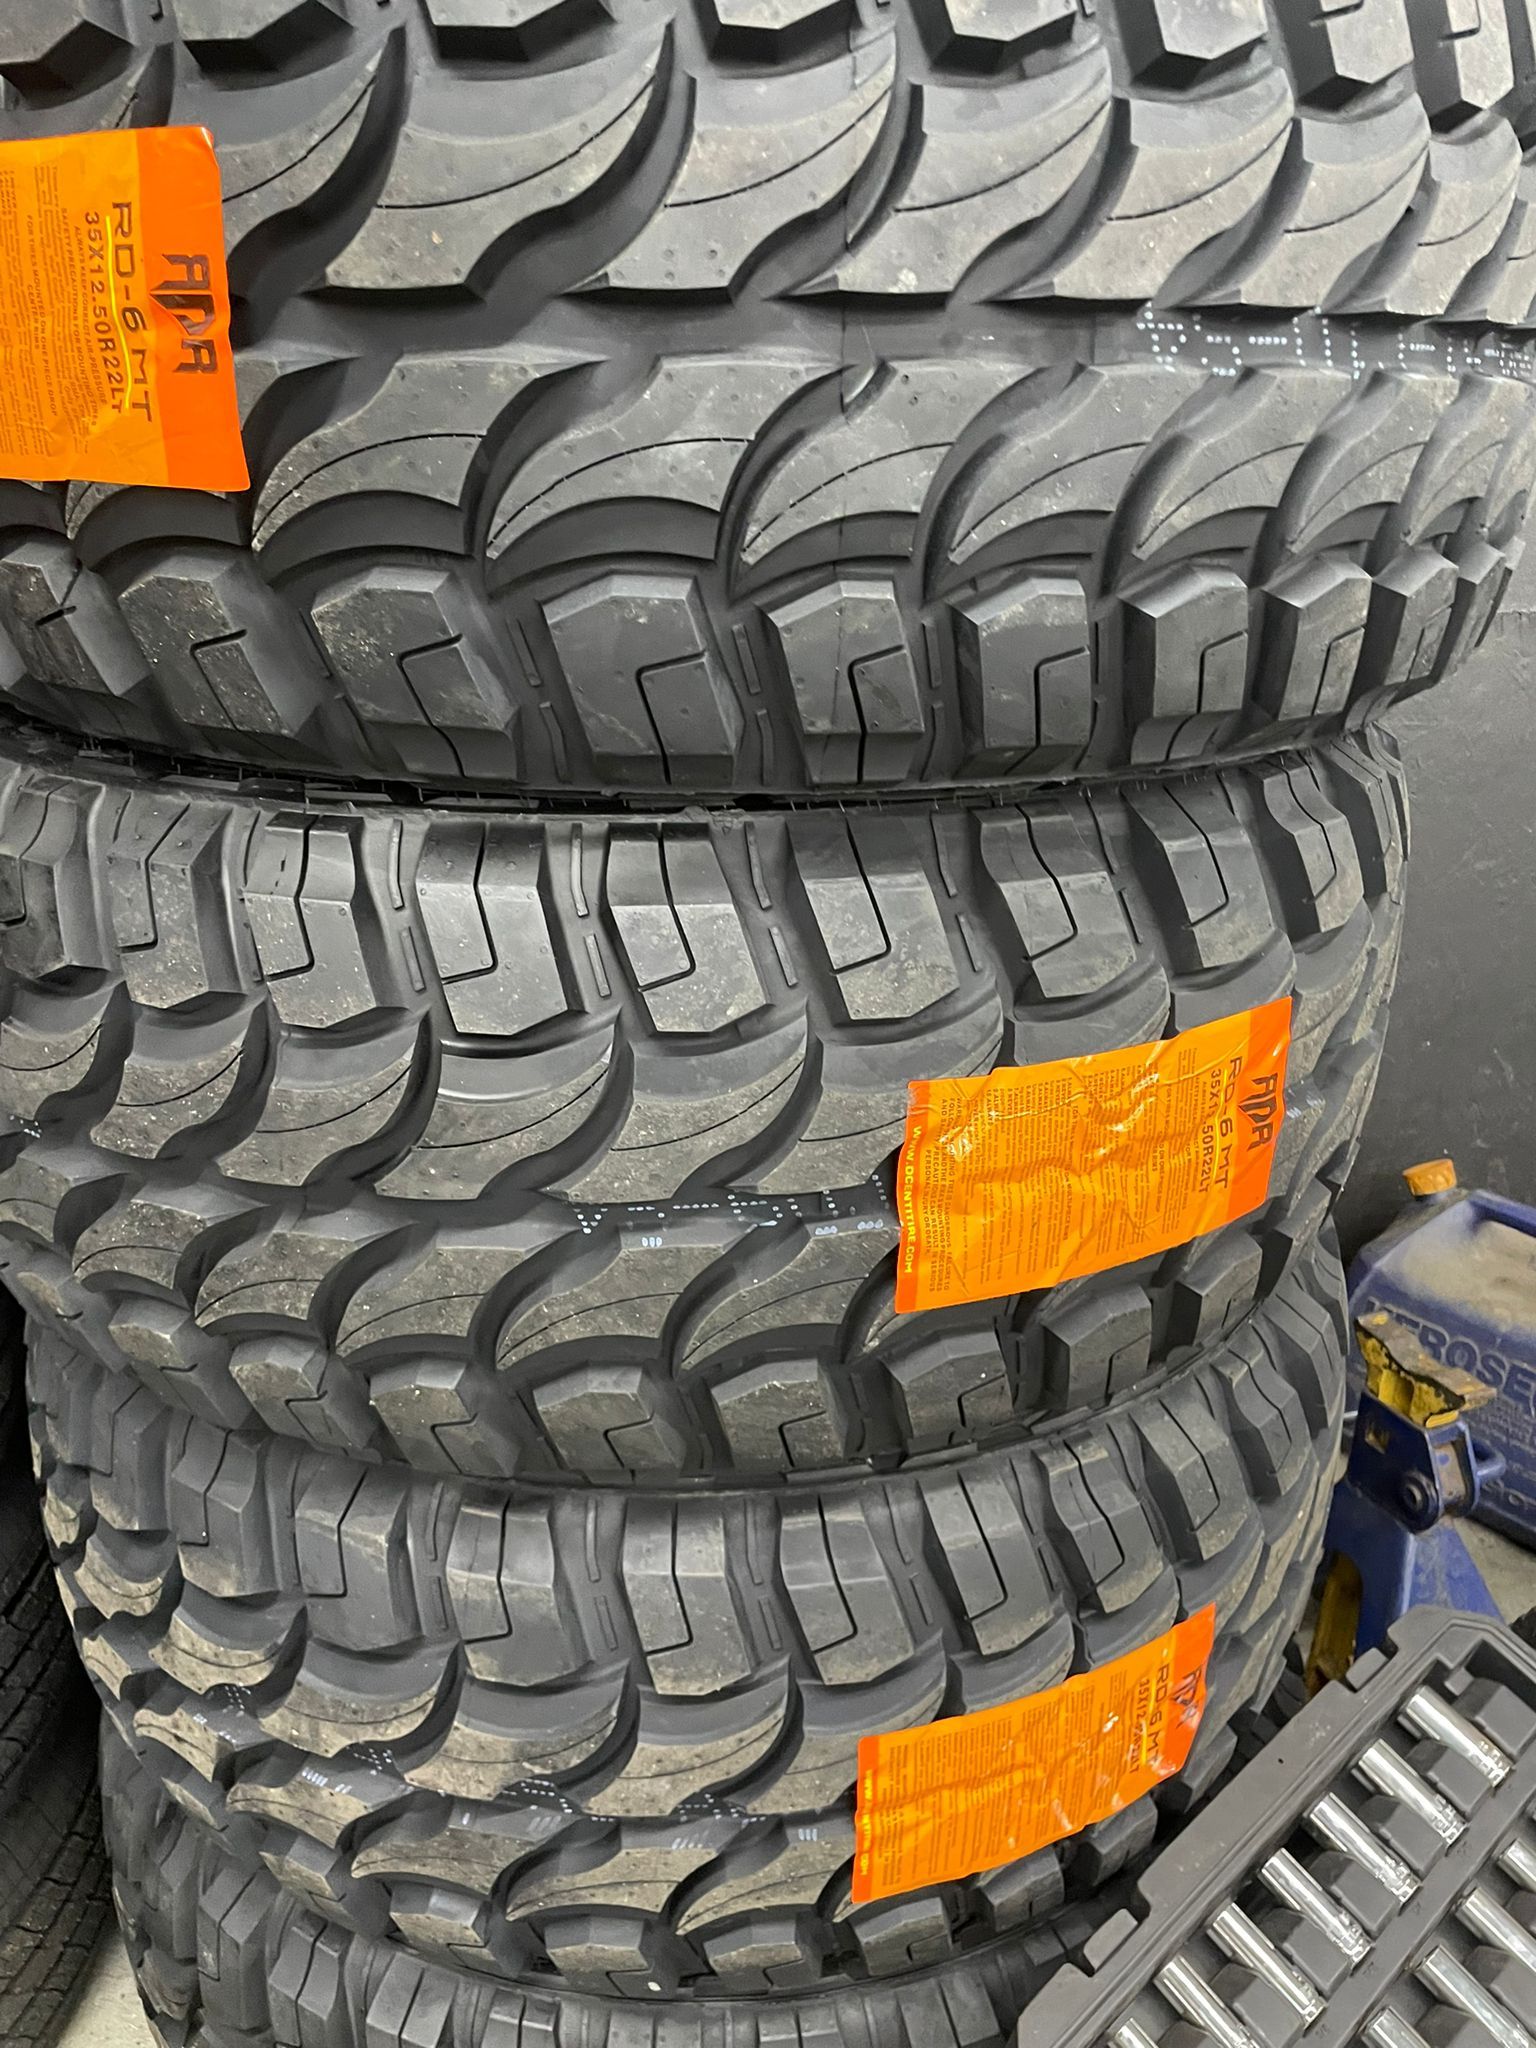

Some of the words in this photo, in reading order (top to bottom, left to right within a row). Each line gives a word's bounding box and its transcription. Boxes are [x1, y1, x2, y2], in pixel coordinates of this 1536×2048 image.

[74, 226, 86, 264] ALWAYS
[33, 269, 46, 318] MOUNTED
[61, 207, 71, 248] SAFETY
[66, 249, 78, 321] PRECAUTIONS
[73, 323, 81, 344] FOR
[77, 346, 92, 393] MOUNTING
[85, 211, 125, 414] 35X12.50R22LT
[112, 202, 147, 333] RD-6
[131, 349, 153, 423] MT
[1220, 1056, 1243, 1137] RD-6
[1214, 1147, 1233, 1189] MT
